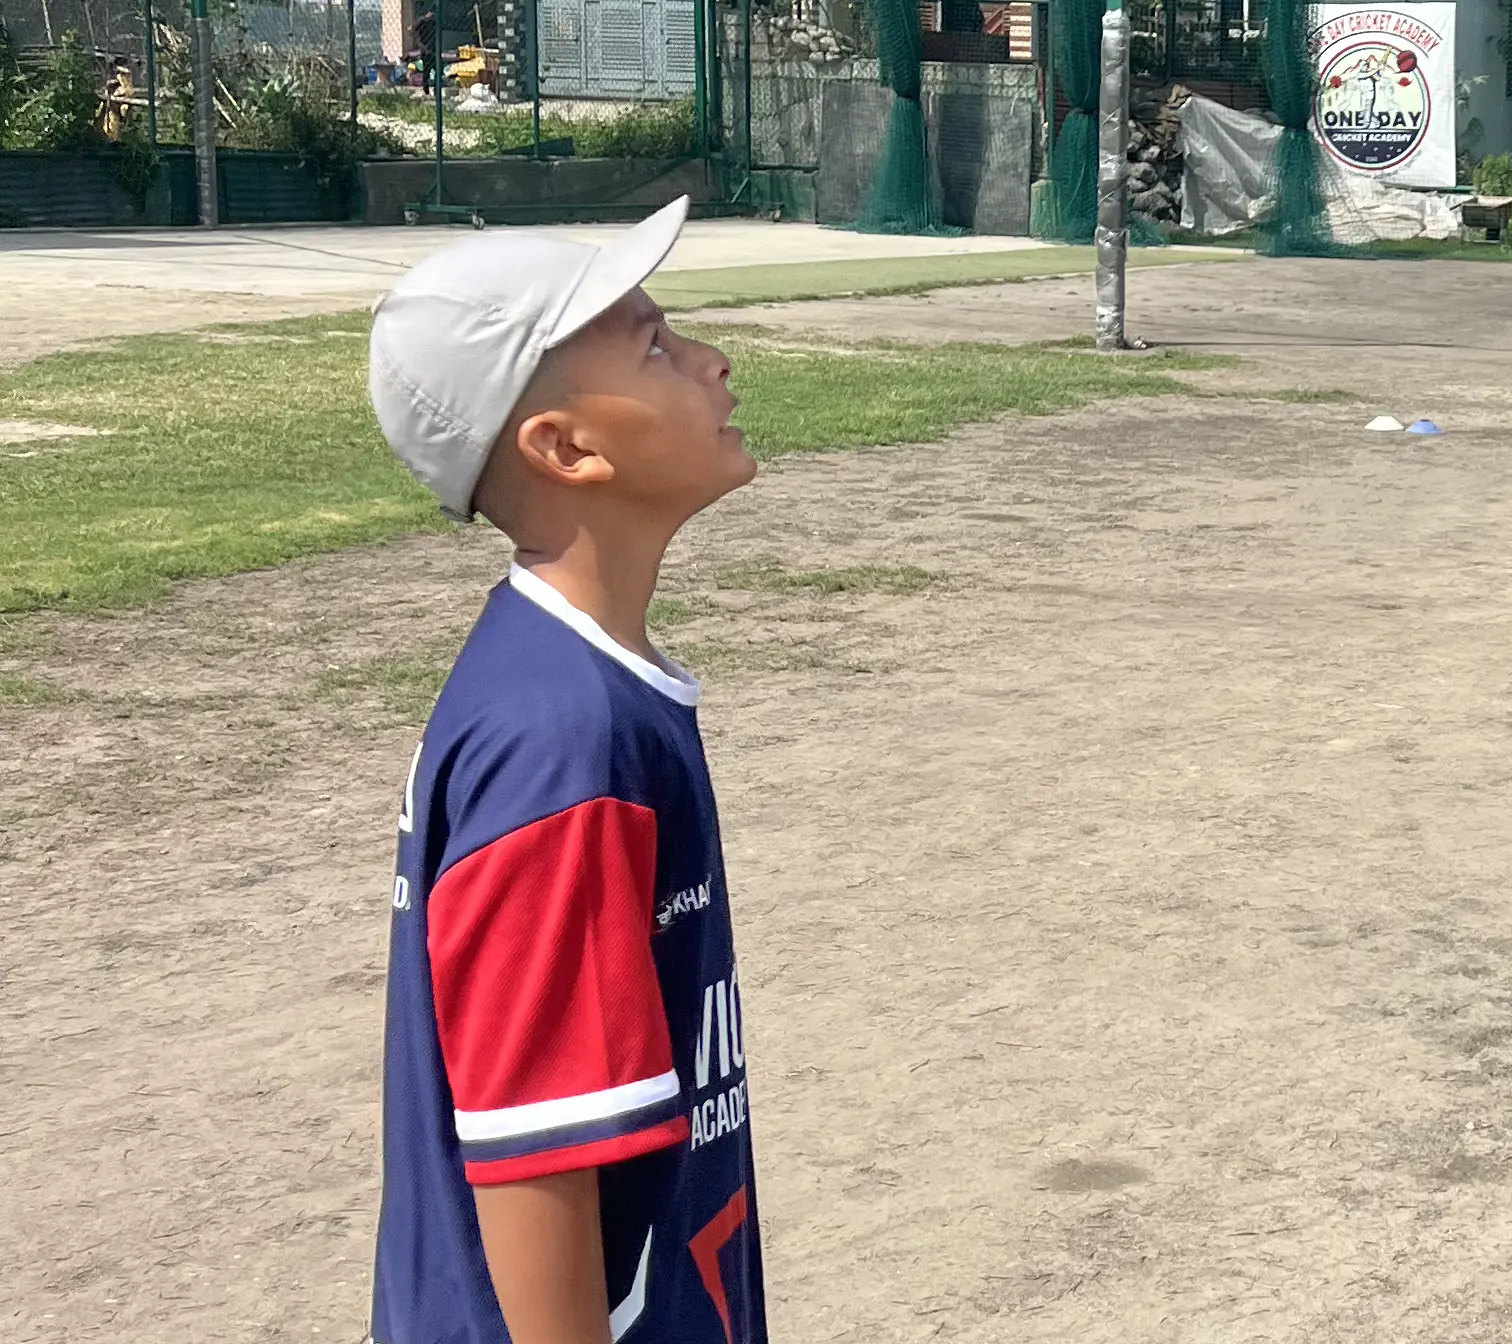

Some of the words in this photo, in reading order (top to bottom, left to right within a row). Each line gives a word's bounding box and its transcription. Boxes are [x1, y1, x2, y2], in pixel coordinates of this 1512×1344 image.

[1349, 13, 1393, 32] CRICKET
[1392, 16, 1440, 53] ACADEMY
[1324, 110, 1365, 127] ONE
[1377, 111, 1422, 127] DAY
